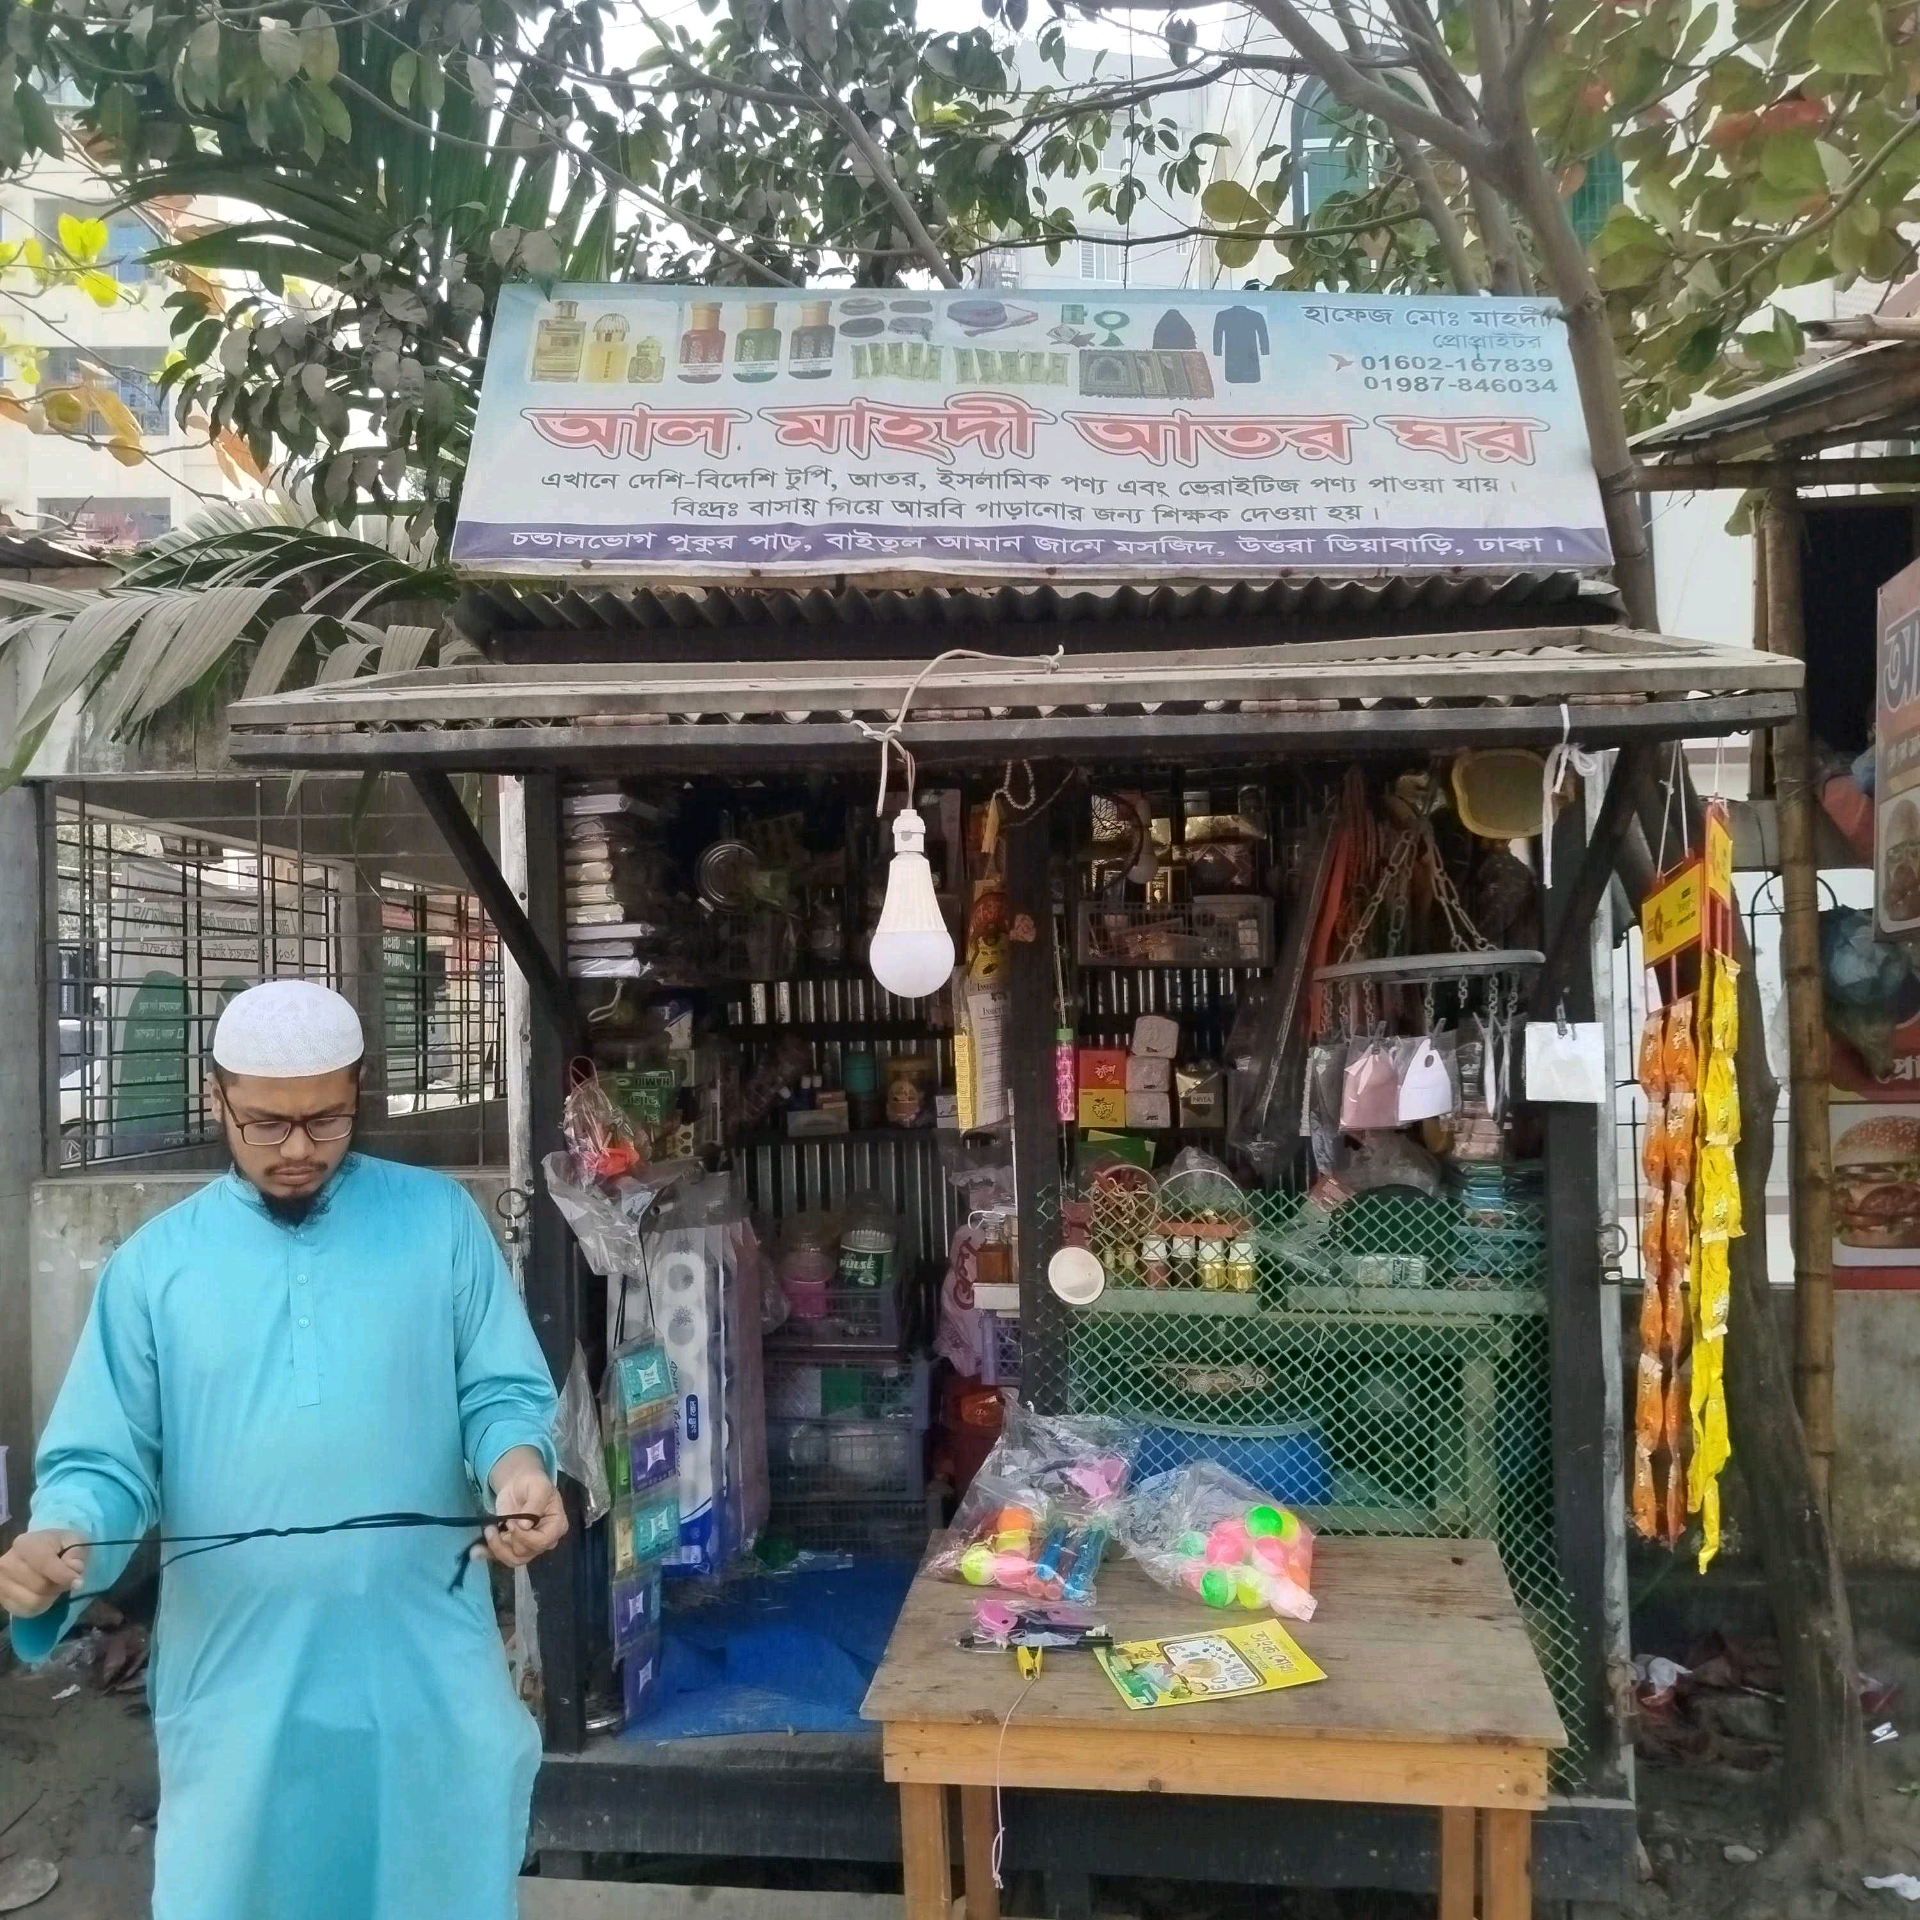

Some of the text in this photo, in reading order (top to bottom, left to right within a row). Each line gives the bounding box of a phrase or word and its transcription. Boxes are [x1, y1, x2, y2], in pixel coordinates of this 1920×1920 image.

[1300, 305, 1394, 326] হাফেজ
[1406, 309, 1460, 327] মোঃ
[1361, 354, 1554, 373] 01602-167839
[1363, 376, 1559, 393] 01987-846034
[520, 391, 1550, 467] আল মাহদী আতর ঘর
[541, 470, 620, 490] এখানে
[628, 468, 778, 490] দেশি-বিদেশি
[785, 464, 838, 492] টুপি,
[847, 470, 926, 492] আতর,
[1060, 475, 1107, 495] পণ্য
[1117, 478, 1170, 498] এবং
[1178, 475, 1302, 498] ভেরাইটিজ
[1310, 477, 1357, 495] পণ্য
[1368, 476, 1446, 495] পাওয়া
[748, 496, 819, 518] বাসায়
[828, 496, 884, 517] গিয়ে
[891, 497, 966, 519] আরবি
[975, 499, 1085, 523] পাড়ানোর
[1091, 506, 1146, 525] জন্য
[1152, 504, 1231, 526] শিক্ষক
[1240, 504, 1319, 524] দেওয়া
[666, 534, 738, 555] পুকুর
[824, 529, 927, 555] বাইতুল
[933, 533, 1025, 553] আমান
[1031, 534, 1106, 554] জামে
[1112, 536, 1226, 557] মসজিদ,
[1235, 536, 1317, 555] উত্তরা
